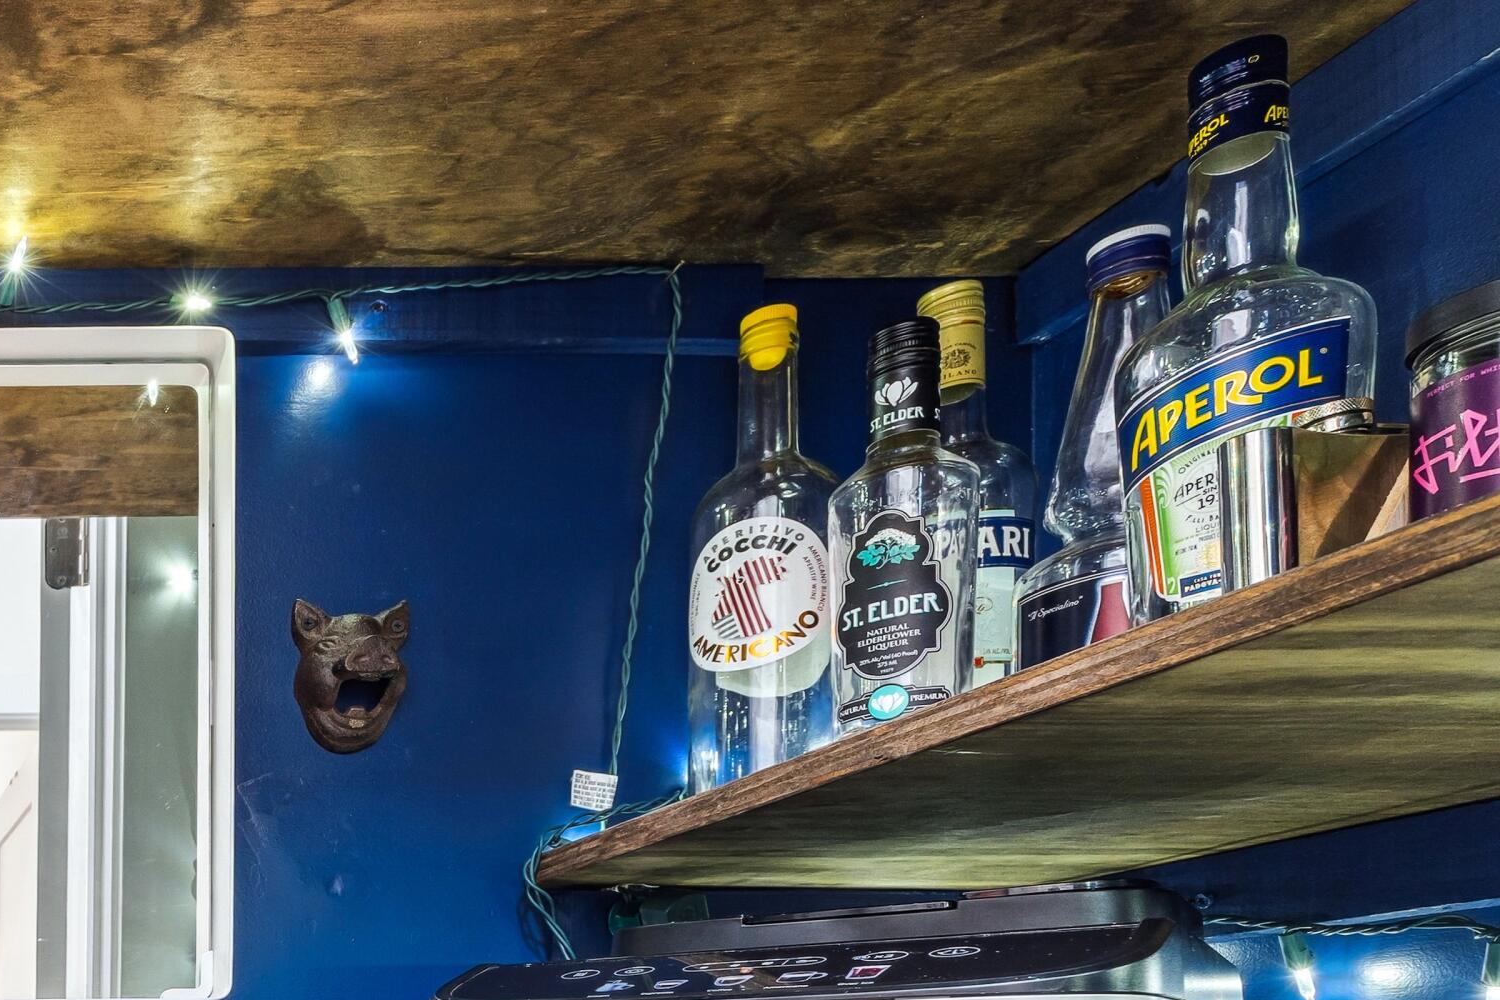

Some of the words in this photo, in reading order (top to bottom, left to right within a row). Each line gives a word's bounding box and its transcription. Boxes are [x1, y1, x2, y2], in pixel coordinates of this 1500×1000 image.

[1264, 104, 1289, 123] APE
[1188, 113, 1230, 157] PEROL
[942, 369, 977, 380] ILANO
[1427, 380, 1455, 398] PERFECT
[1460, 372, 1475, 383] FOR
[869, 417, 882, 433] ST.
[883, 406, 924, 426] ELDER
[1131, 348, 1324, 473] APEROL
[1413, 409, 1500, 496] Filt
[1173, 472, 1219, 503] APER
[1202, 485, 1218, 496] SIN
[1197, 494, 1219, 510] 19
[1195, 522, 1221, 533] LIQU
[703, 524, 805, 565] APERITIVO
[707, 534, 797, 573] COCCHI
[803, 555, 817, 583] APERITIF
[808, 545, 828, 584] AMERICANO
[817, 584, 828, 612] BIANCO
[841, 607, 865, 632] ST.
[866, 622, 910, 638] NATURAL
[693, 610, 820, 663] AMERICANO
[857, 628, 922, 649] ELDERFLOWER
[867, 638, 909, 653] LIQUEUR
[910, 692, 948, 701] PREMIUM
[840, 703, 868, 717] NATURAL
